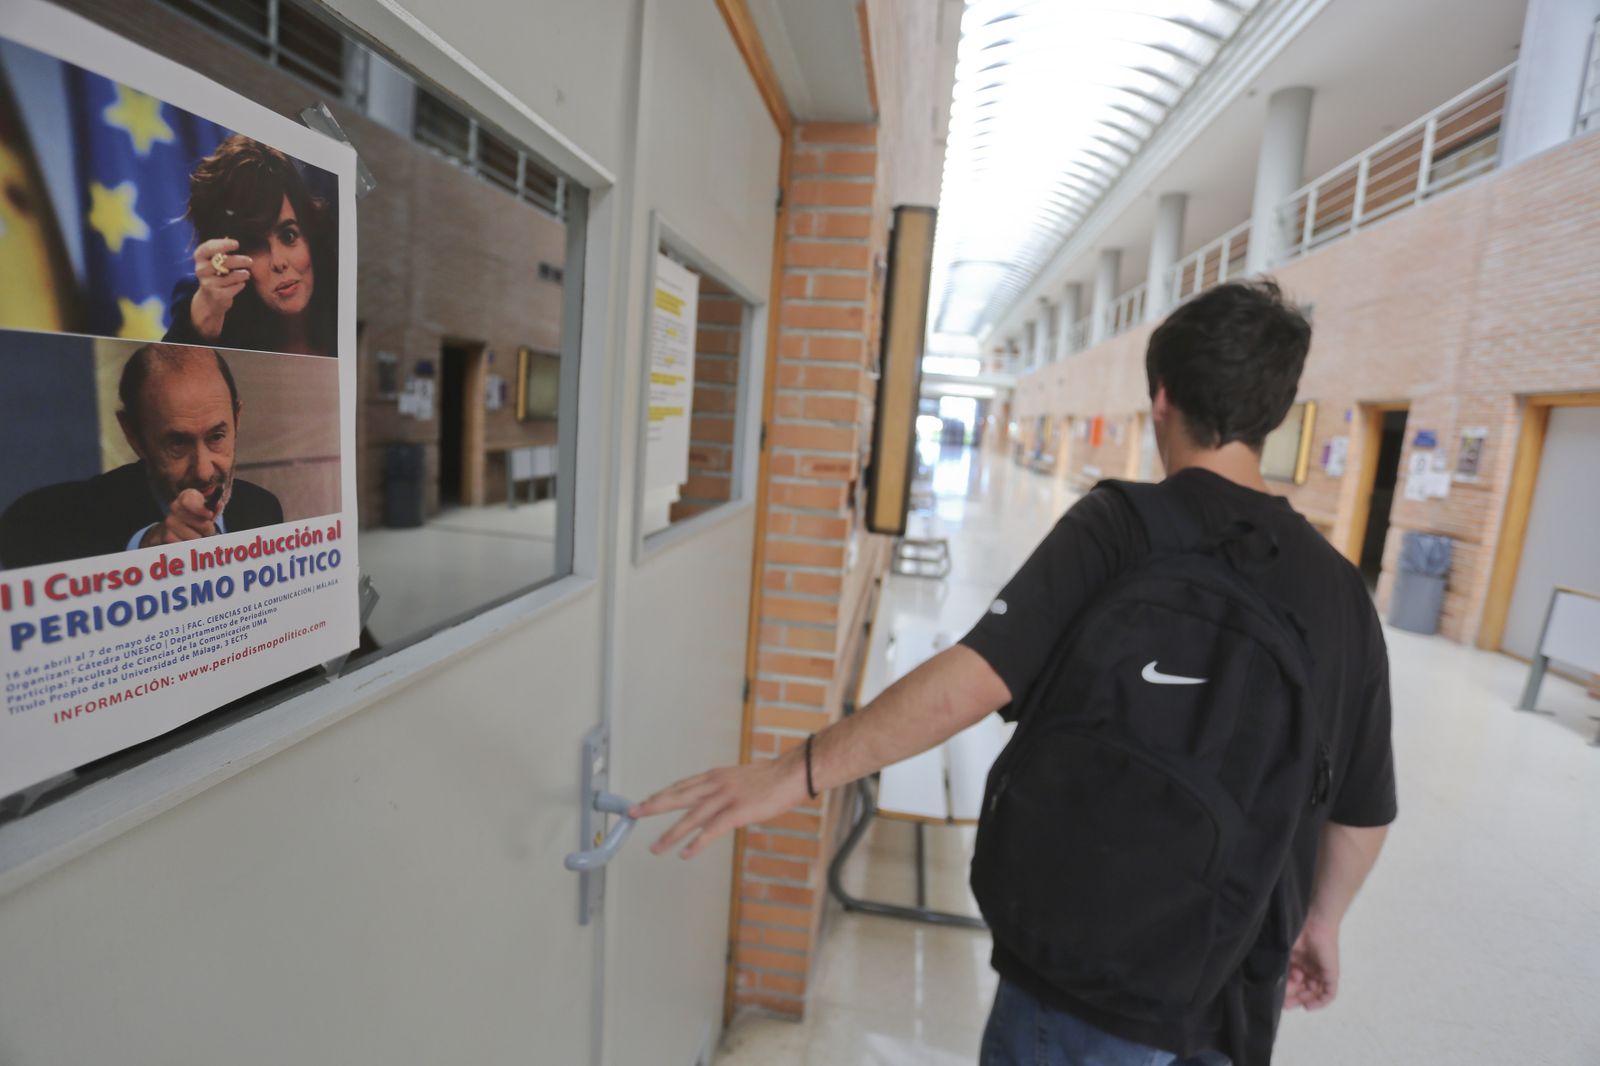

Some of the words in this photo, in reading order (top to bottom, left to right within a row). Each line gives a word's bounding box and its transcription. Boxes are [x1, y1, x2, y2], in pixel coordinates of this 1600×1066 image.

[10, 574, 235, 651] PERIODISMO
[242, 548, 342, 592] POLÍTICO
[44, 566, 143, 601] Curso
[150, 553, 184, 580] de
[191, 526, 323, 571] Introducción
[327, 519, 342, 542] al
[6, 667, 76, 693] Organizan:
[123, 641, 162, 660] UNESCO
[170, 622, 228, 646] Departamento
[230, 618, 239, 628] de
[240, 607, 278, 623] Periodismo
[7, 680, 68, 704] Participa:
[71, 664, 119, 686] Facultad
[121, 661, 134, 671] de
[136, 648, 175, 666] Ciencias
[177, 643, 187, 653] de
[189, 640, 197, 650] la
[252, 617, 268, 629] UMA
[25, 666, 39, 676] de
[43, 655, 72, 670] abril
[75, 651, 86, 662] al
[88, 649, 95, 659] 7
[98, 646, 113, 656] de
[115, 639, 143, 652] mayo
[144, 633, 157, 643] de
[159, 626, 180, 639] 2013
[187, 618, 205, 631] FAC.
[207, 607, 241, 625] CIENCIAS
[243, 603, 252, 614] DE
[254, 601, 263, 611] LA
[49, 686, 89, 703] Propio
[91, 681, 105, 691] de
[107, 677, 118, 686] la
[121, 656, 178, 682] Universidad
[179, 652, 191, 663] de
[224, 639, 230, 648] 3
[231, 632, 249, 645] ECTS
[53, 676, 175, 724] INFORMACIÓN:
[178, 620, 327, 682] www.periodismopolitico.com
